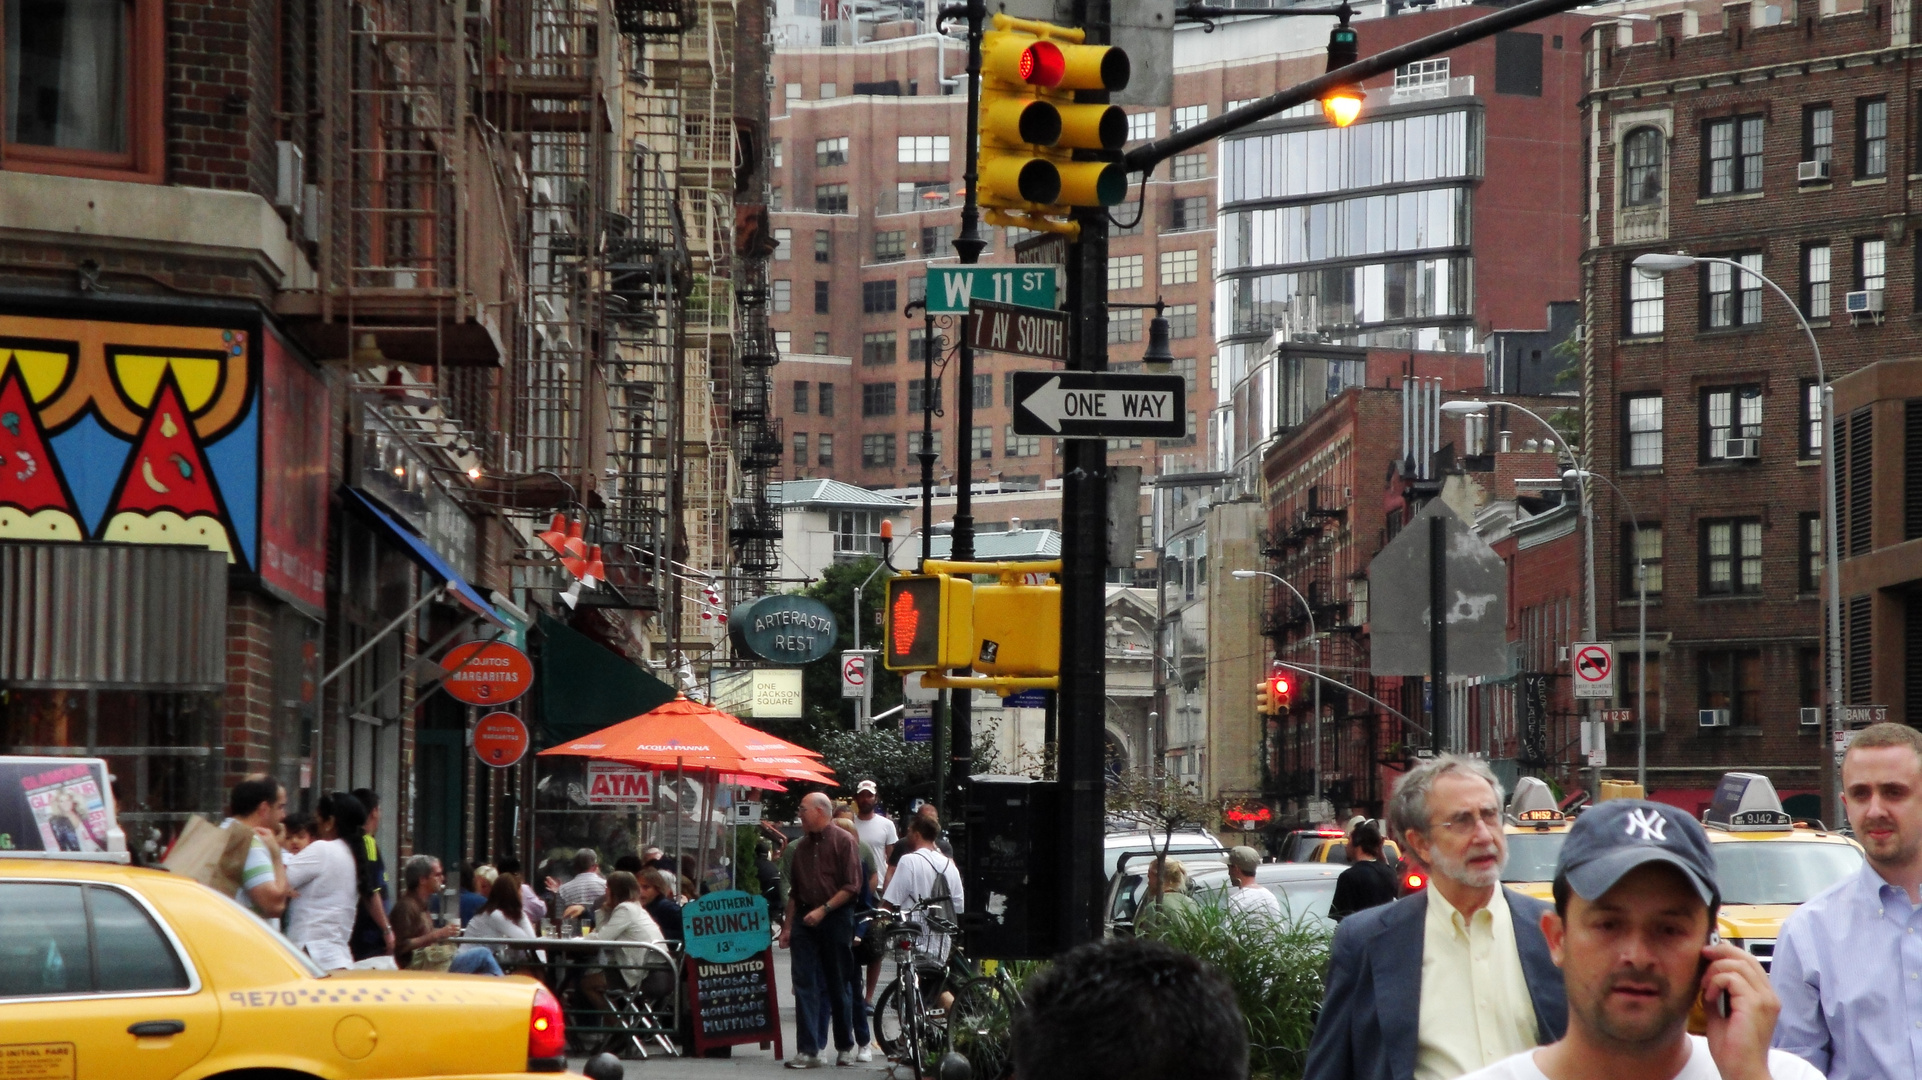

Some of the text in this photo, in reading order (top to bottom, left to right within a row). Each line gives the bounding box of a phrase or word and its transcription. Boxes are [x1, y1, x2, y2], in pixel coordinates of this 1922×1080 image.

[943, 272, 1045, 307] W 11 ST
[974, 308, 1064, 357] 7 AV SOUTH
[1064, 392, 1167, 418] ONE WAY
[755, 610, 831, 635] ARTERASTA
[775, 634, 815, 651] REST
[453, 672, 518, 682] MARGARITAS
[757, 690, 800, 698] JACKSON
[1602, 711, 1630, 720] W 12 ST
[1846, 708, 1887, 720] BANK ST
[590, 774, 650, 796] ATM
[1530, 811, 1552, 820] 1H52
[1747, 813, 1773, 824] 9J42
[1625, 808, 1667, 841] NY
[699, 896, 754, 912] SOUTHERN
[692, 912, 759, 936] BRUNCH
[698, 961, 765, 978] UNLIMITED
[698, 973, 760, 990] MIMOSAS
[229, 990, 297, 1008] 9E70
[700, 1000, 765, 1017] HOMEMADE
[702, 1014, 766, 1033] MUFFINS
